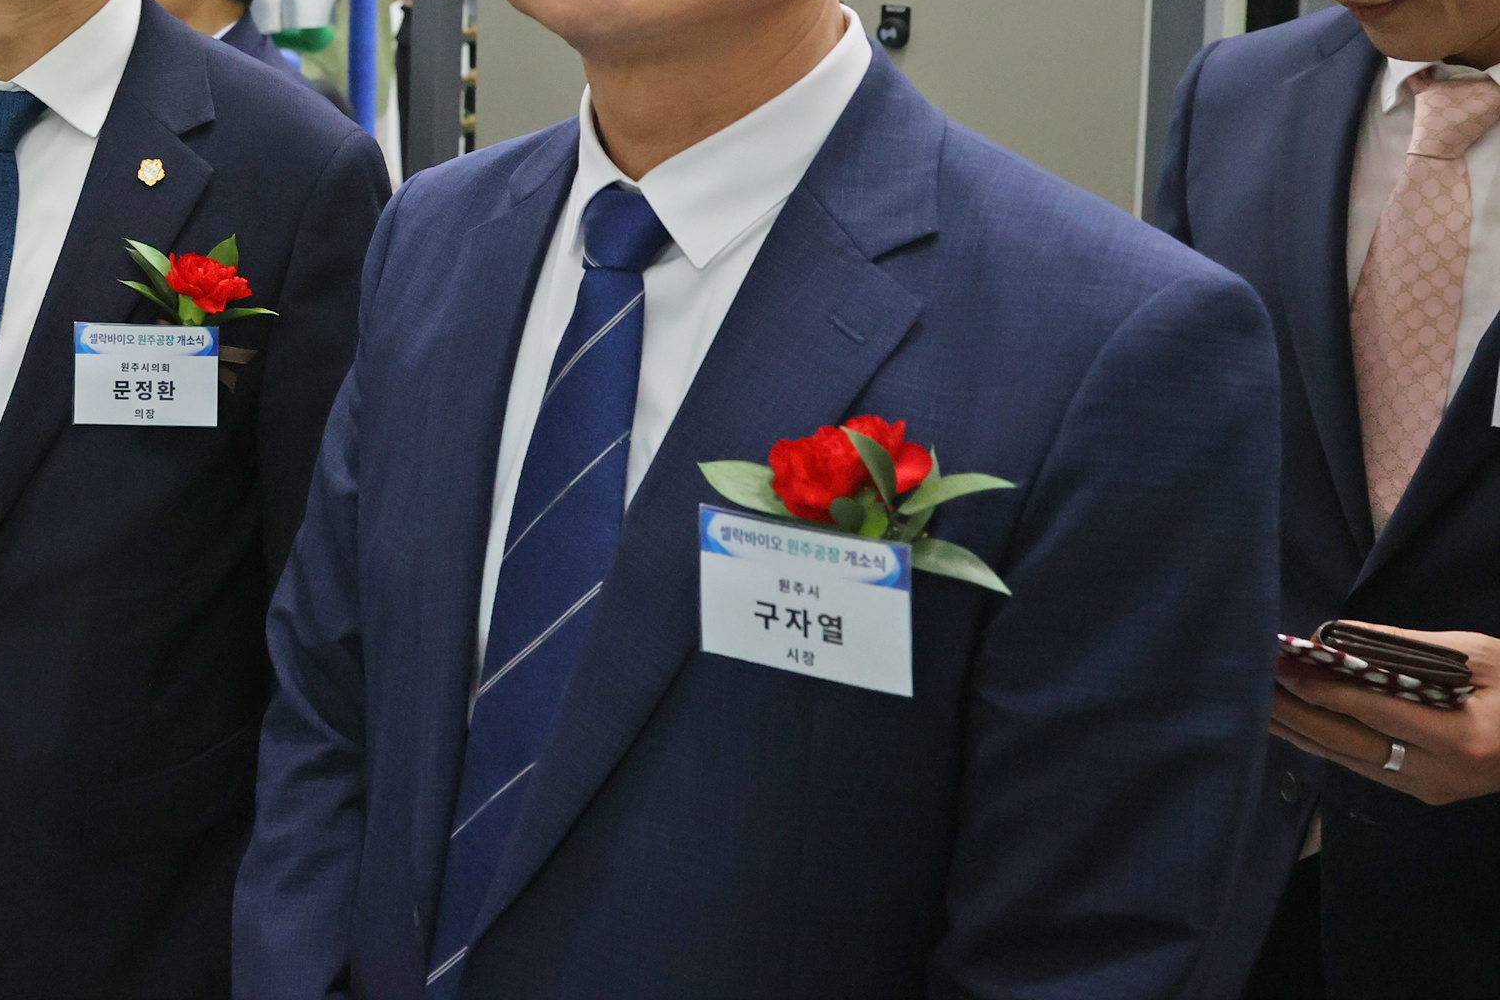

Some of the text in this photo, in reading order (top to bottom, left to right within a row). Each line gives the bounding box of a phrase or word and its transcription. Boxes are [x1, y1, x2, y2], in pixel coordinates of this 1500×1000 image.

[89, 332, 205, 347] 셀락바이오 원주공장 개소식
[121, 362, 170, 373] 원주시의회
[112, 380, 176, 401] 문정환
[134, 409, 155, 419] 의장
[719, 525, 887, 572] 셀락바이오 원주공장 개소식
[779, 578, 819, 599] 원주시
[754, 600, 844, 646] 구자열
[787, 648, 815, 667] 시장
